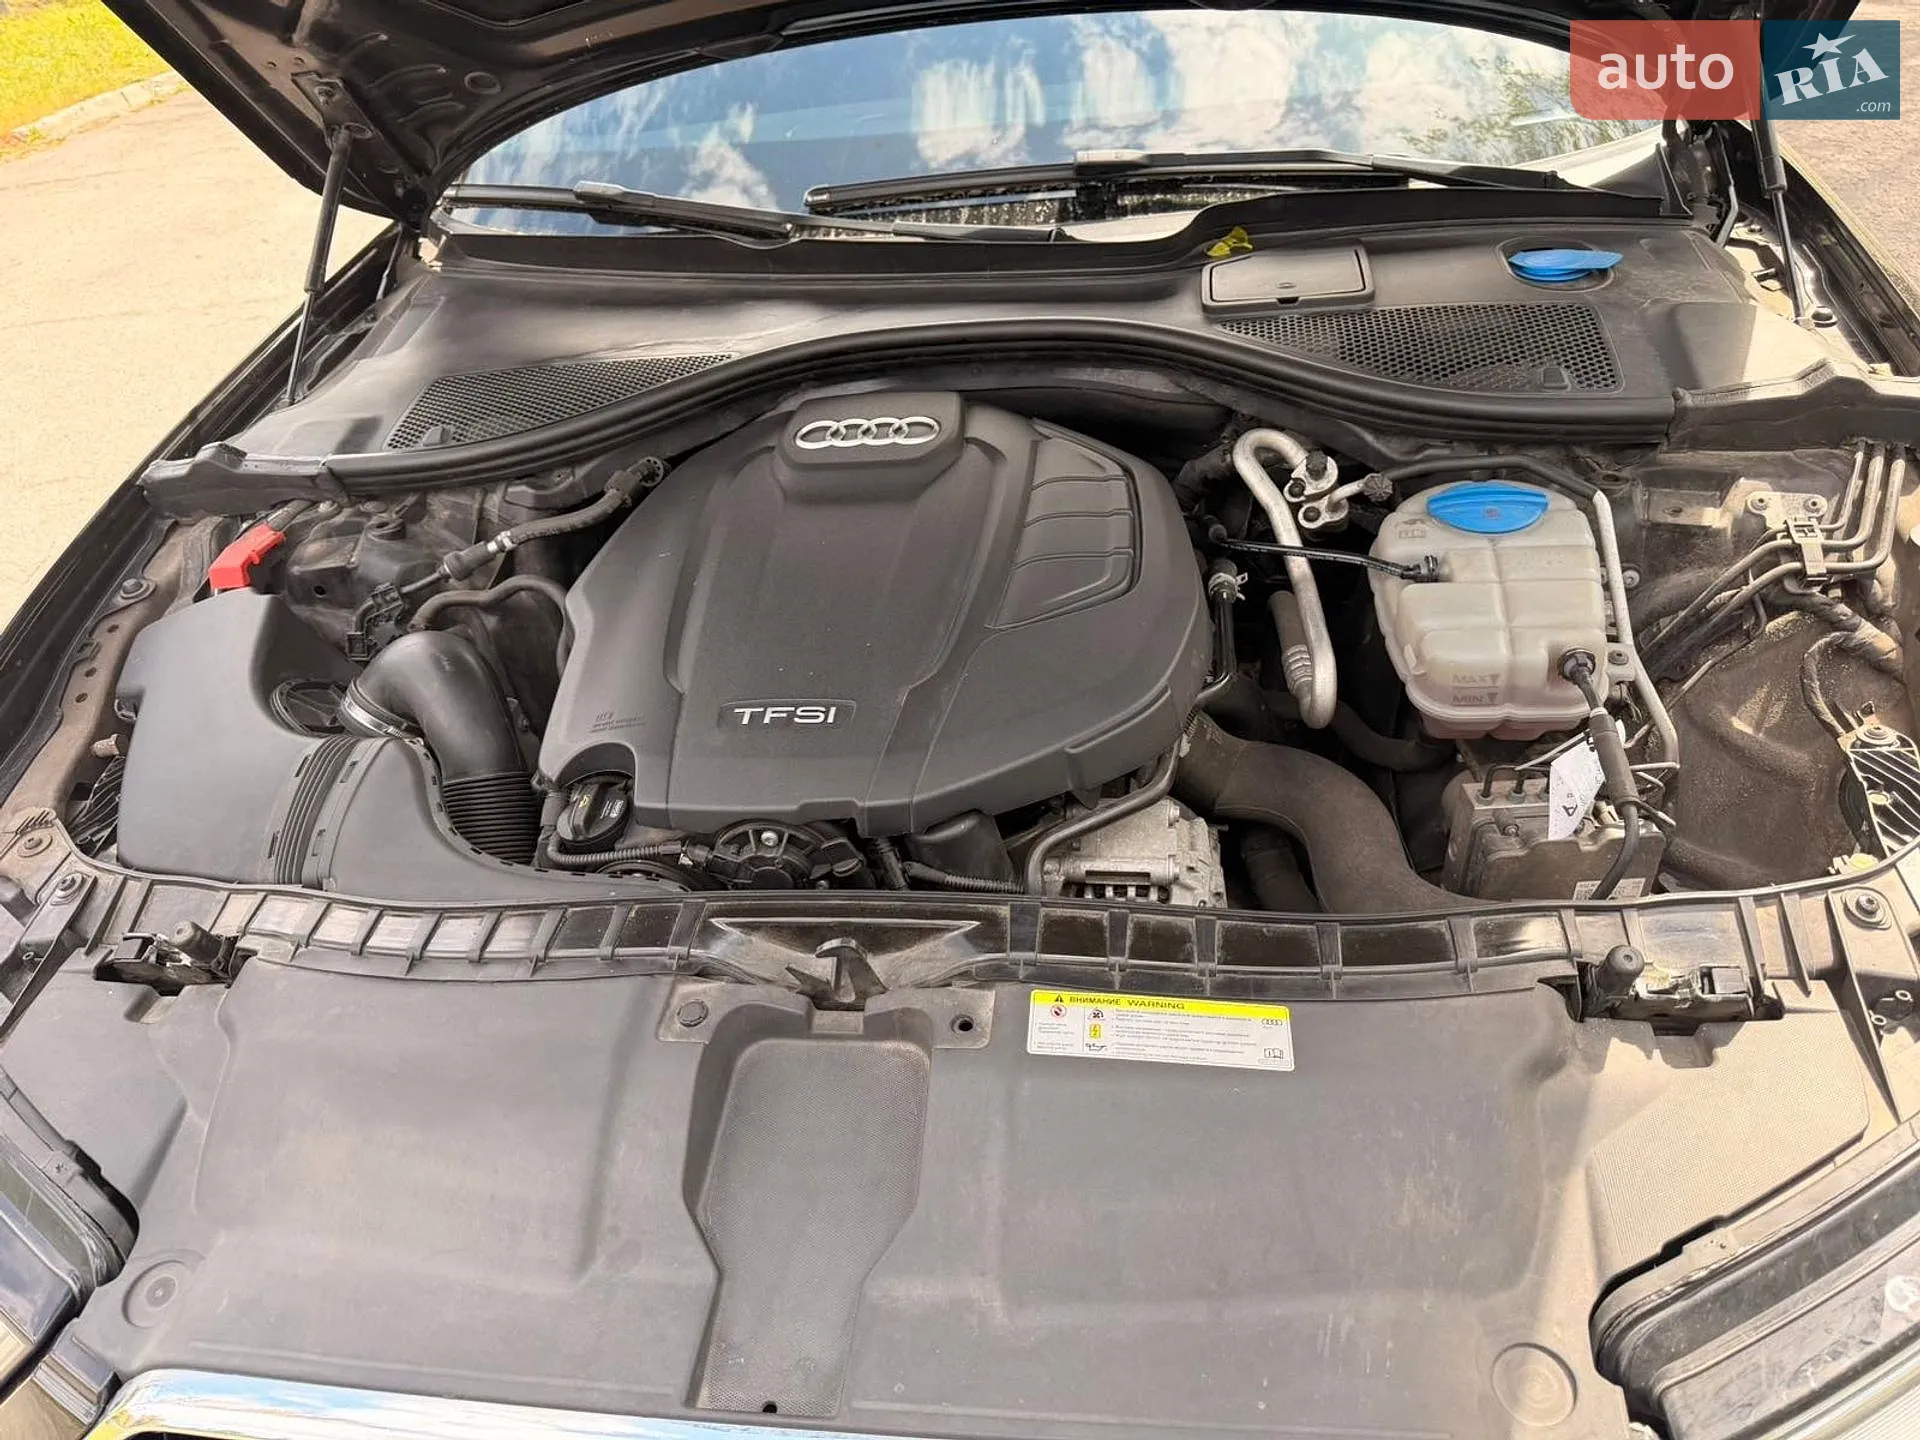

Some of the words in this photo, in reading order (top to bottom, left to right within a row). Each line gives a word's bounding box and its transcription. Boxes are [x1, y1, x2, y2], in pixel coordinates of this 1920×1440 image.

[1452, 673, 1488, 685] MAX
[1452, 694, 1483, 704] MIN
[733, 706, 837, 725] TFSI
[1069, 995, 1121, 1006] ВНИМАНИЕ
[1127, 999, 1185, 1010] WARNING
